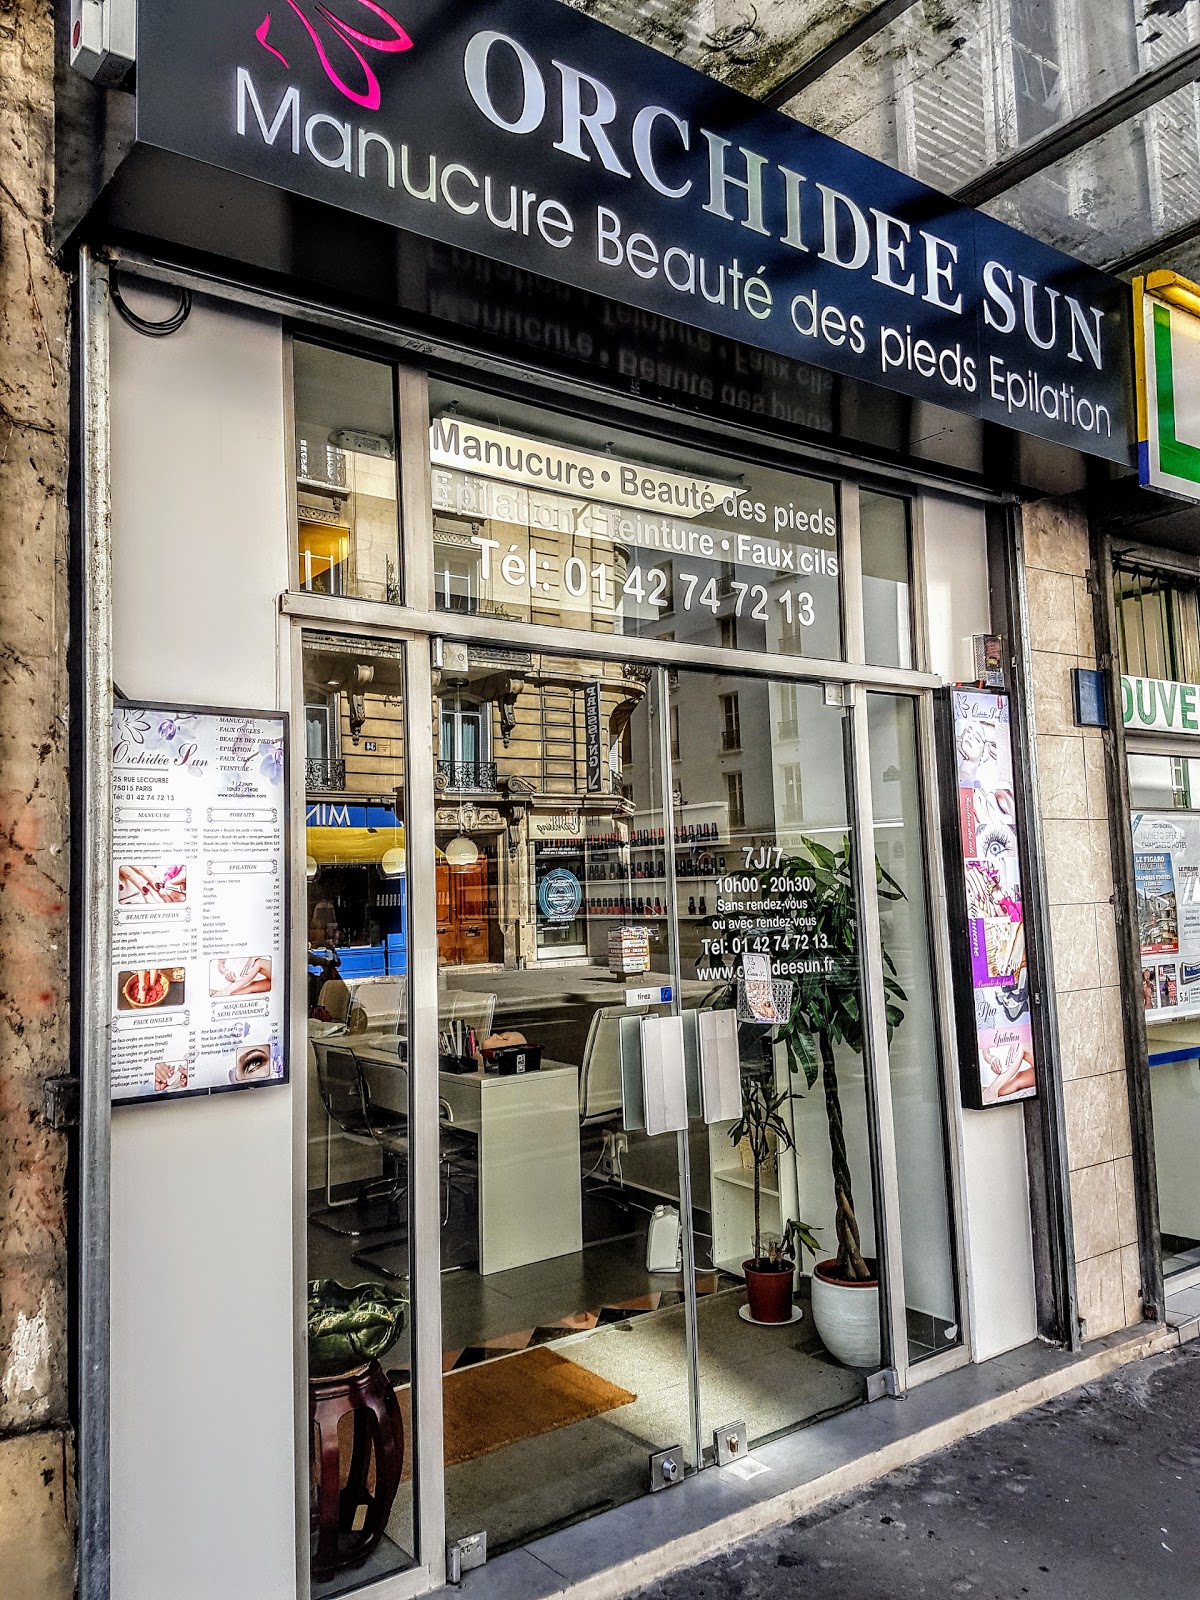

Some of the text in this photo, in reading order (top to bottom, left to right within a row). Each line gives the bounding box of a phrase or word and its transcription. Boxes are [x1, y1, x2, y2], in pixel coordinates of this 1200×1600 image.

[464, 30, 1105, 371] ORCHIDEE SUN
[235, 66, 575, 249] Manucure
[597, 205, 774, 321] Beauté
[790, 289, 867, 354] des
[880, 325, 978, 392] pieds
[989, 355, 1112, 437] Epilation
[432, 418, 837, 538] Manucure Beauté des pieds
[431, 469, 839, 577] Epilation Teinture Faux cils
[470, 536, 816, 627] Tél: 01 42 74 72 13
[113, 740, 209, 766] Orchidée Sun
[136, 776, 169, 784] LECOURBE
[742, 846, 784, 869] 7J/7
[715, 877, 759, 893] 10h00
[770, 876, 811, 893] 20h30
[717, 898, 808, 912] Sans rendez-vous
[712, 915, 817, 930] ou avec rendez-vous
[701, 933, 828, 956] Tél: 01 42 74 72 13
[696, 957, 834, 981] www.odeesun.fr
[978, 1001, 997, 1022] Spa
